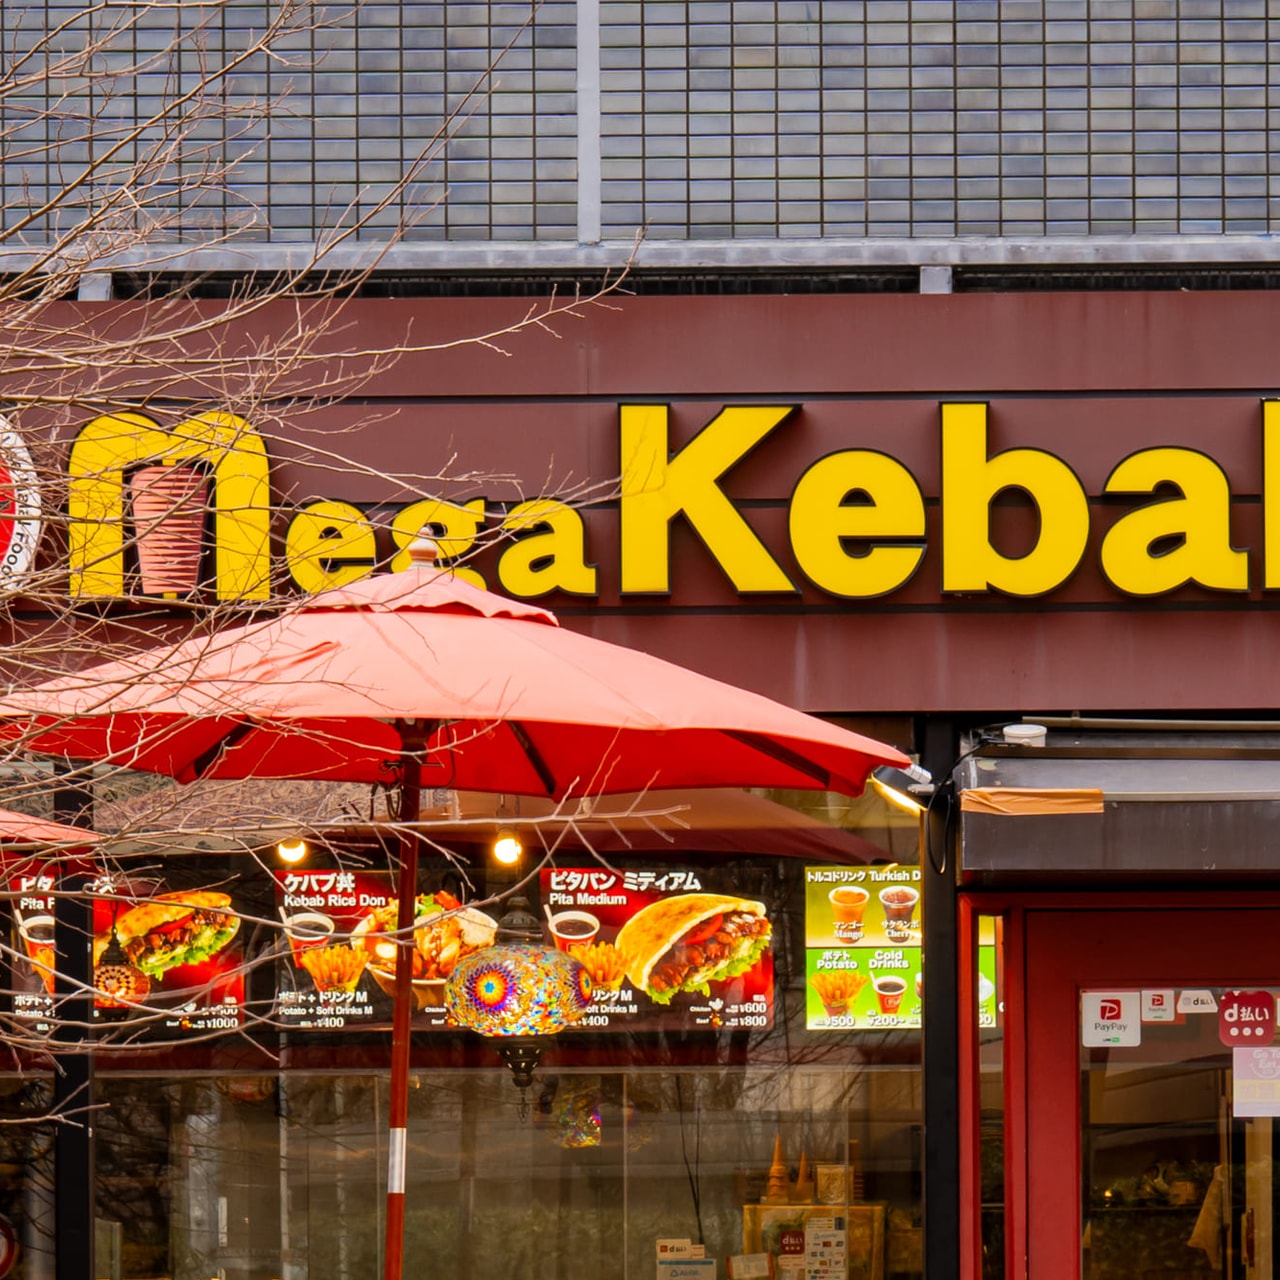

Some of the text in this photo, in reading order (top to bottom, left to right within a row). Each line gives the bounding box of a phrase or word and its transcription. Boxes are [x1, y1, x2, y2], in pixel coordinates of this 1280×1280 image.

[623, 872, 702, 890] ミディアム
[870, 870, 910, 881] Turkish
[284, 873, 355, 893] ケバブ丼
[20, 898, 45, 910] Pita
[284, 894, 385, 907] Kebab Rice Don
[549, 893, 626, 904] Pita Medium
[875, 951, 902, 960] Cold
[817, 960, 857, 969] Potato
[869, 960, 909, 969] Drinks
[336, 1006, 362, 1015] Drinks
[1224, 1004, 1269, 1022] d払い
[1094, 1022, 1128, 1032] PayPay
